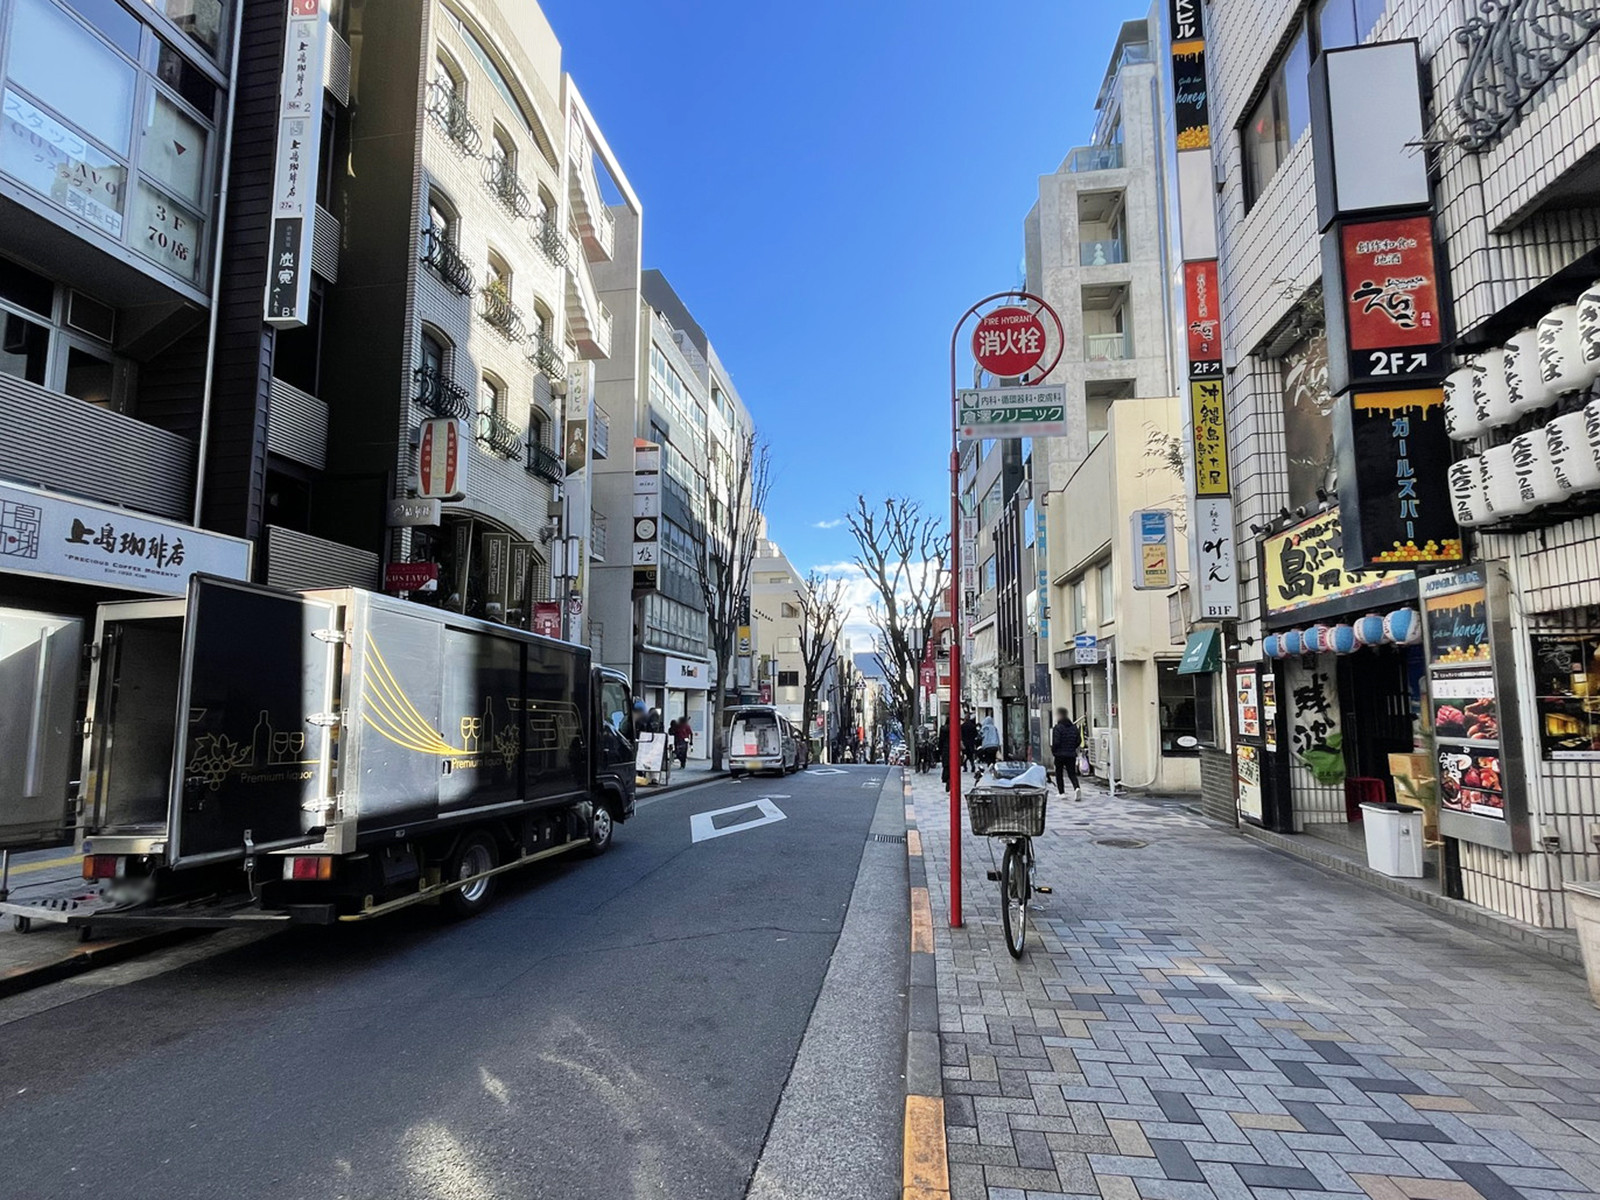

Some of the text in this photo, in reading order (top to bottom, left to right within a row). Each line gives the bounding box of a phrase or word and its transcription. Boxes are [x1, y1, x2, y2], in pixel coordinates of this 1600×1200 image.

[294, 41, 308, 98] 上島珈琲店
[304, 103, 311, 113] 2
[1176, 86, 1206, 109] honey
[5, 97, 84, 155] スタッフ
[287, 139, 301, 198] 上島珈琲店
[66, 188, 120, 230] 募集中
[298, 204, 302, 212] 1
[148, 226, 189, 261] 70席
[984, 315, 1033, 325] FIRE HYDRANT
[979, 327, 1041, 357] 消火栓
[1538, 317, 1566, 386] へぎそば
[1193, 362, 1209, 374] 2F
[1369, 351, 1404, 376] 2F
[1503, 341, 1524, 404] へぎそば
[1472, 362, 1490, 422] へぎそば
[1200, 383, 1222, 485] 沖縄島ぶた屋
[1392, 417, 1419, 539] ガールズバー
[64, 517, 185, 569] 上島珈琲店
[1209, 606, 1232, 615] B1F
[1453, 617, 1486, 645] honey
[241, 768, 314, 784] Premium liquor
[451, 757, 484, 770] Premium
